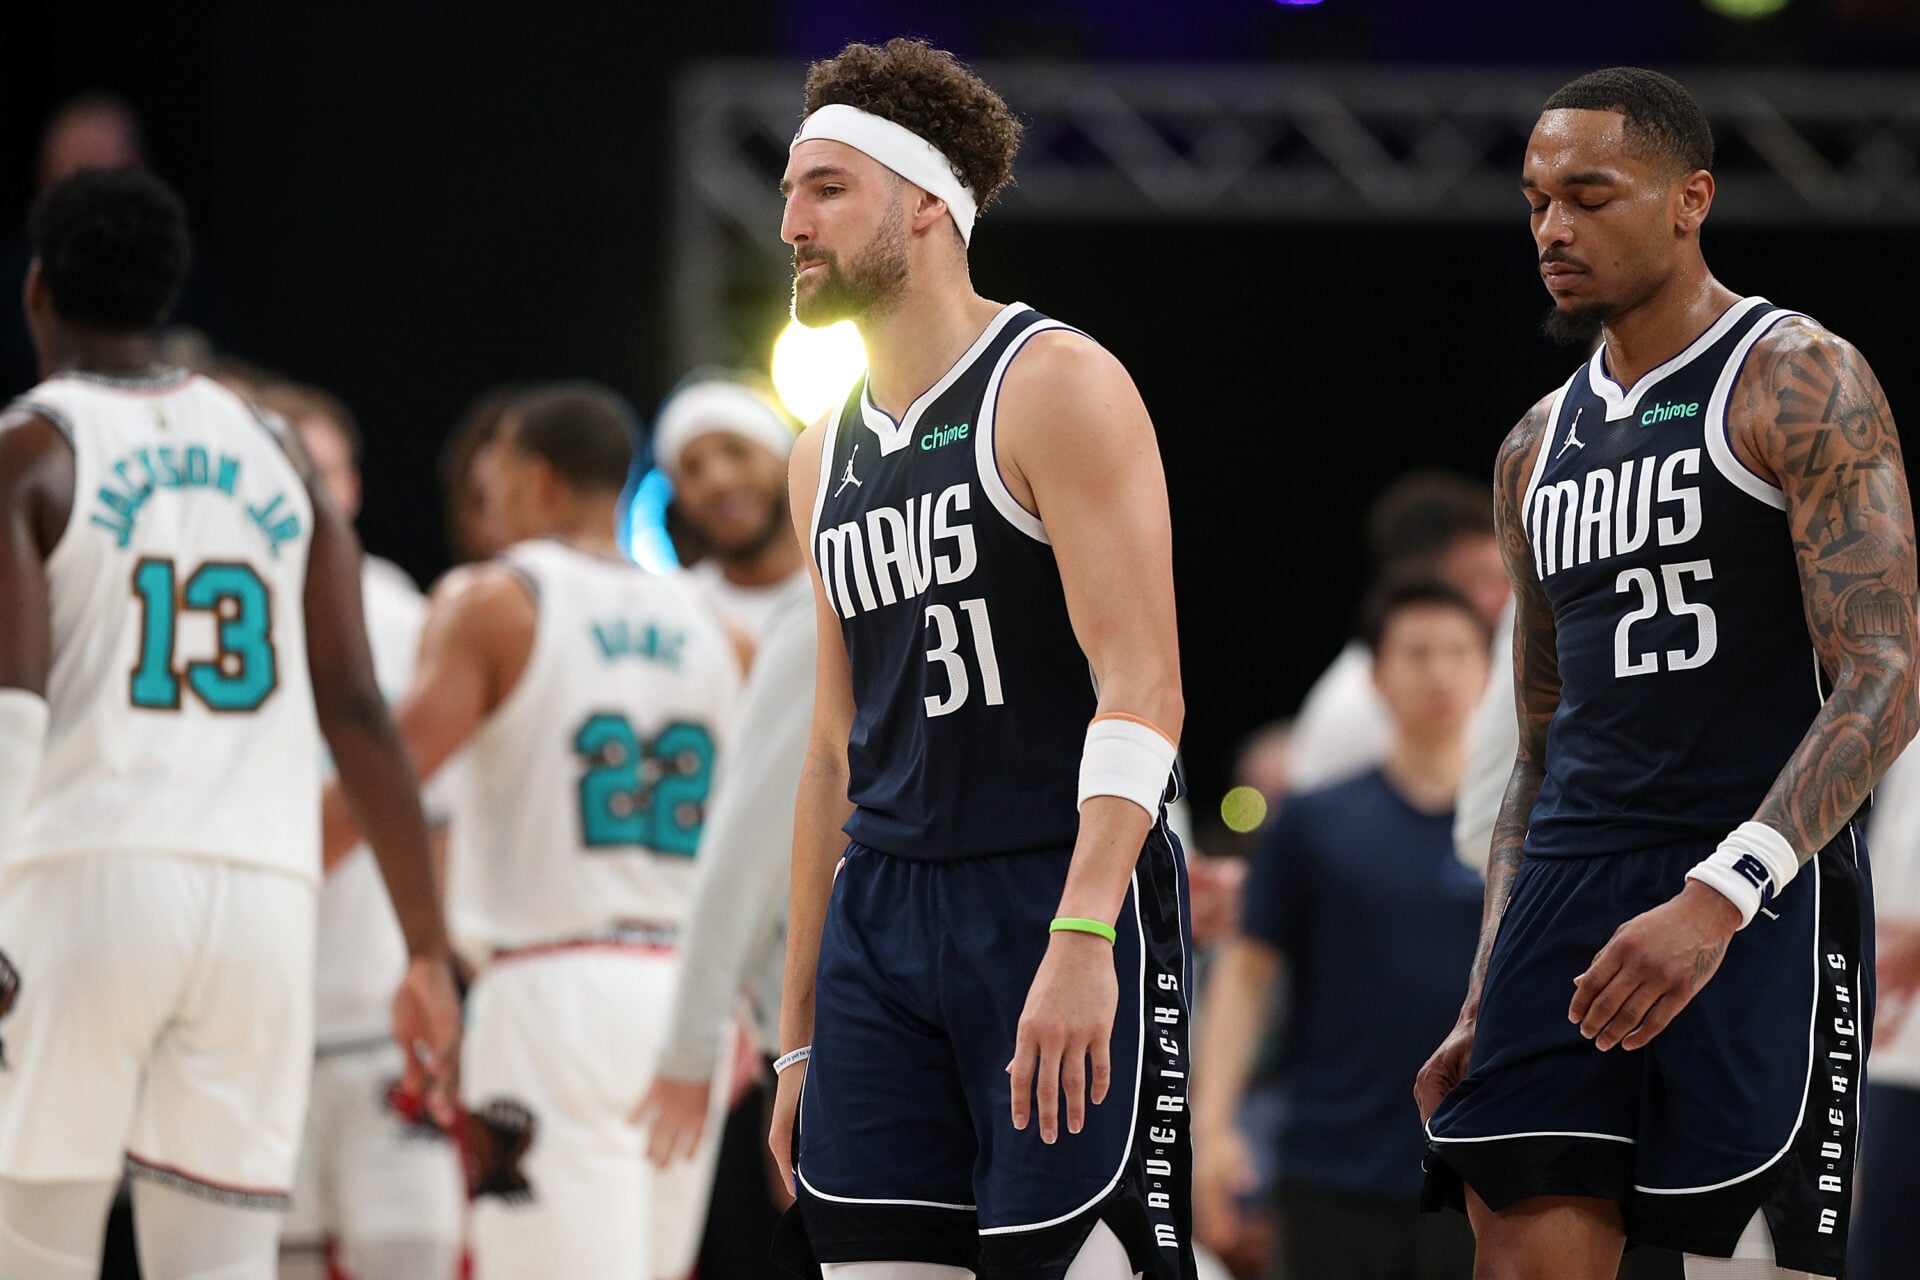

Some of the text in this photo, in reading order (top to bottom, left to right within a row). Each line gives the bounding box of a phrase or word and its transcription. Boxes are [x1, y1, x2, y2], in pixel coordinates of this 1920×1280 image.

[920, 422, 969, 451] chime
[1640, 400, 1700, 426] chime
[819, 482, 978, 619] MAVS
[1532, 448, 1702, 582] MAVS
[130, 556, 278, 713] 13
[924, 598, 1004, 718] 31
[1614, 559, 1718, 678] 25
[573, 713, 716, 861] 22
[1146, 973, 1185, 1249] MAVERICKS
[1818, 953, 1855, 1235] MAVERICKS
